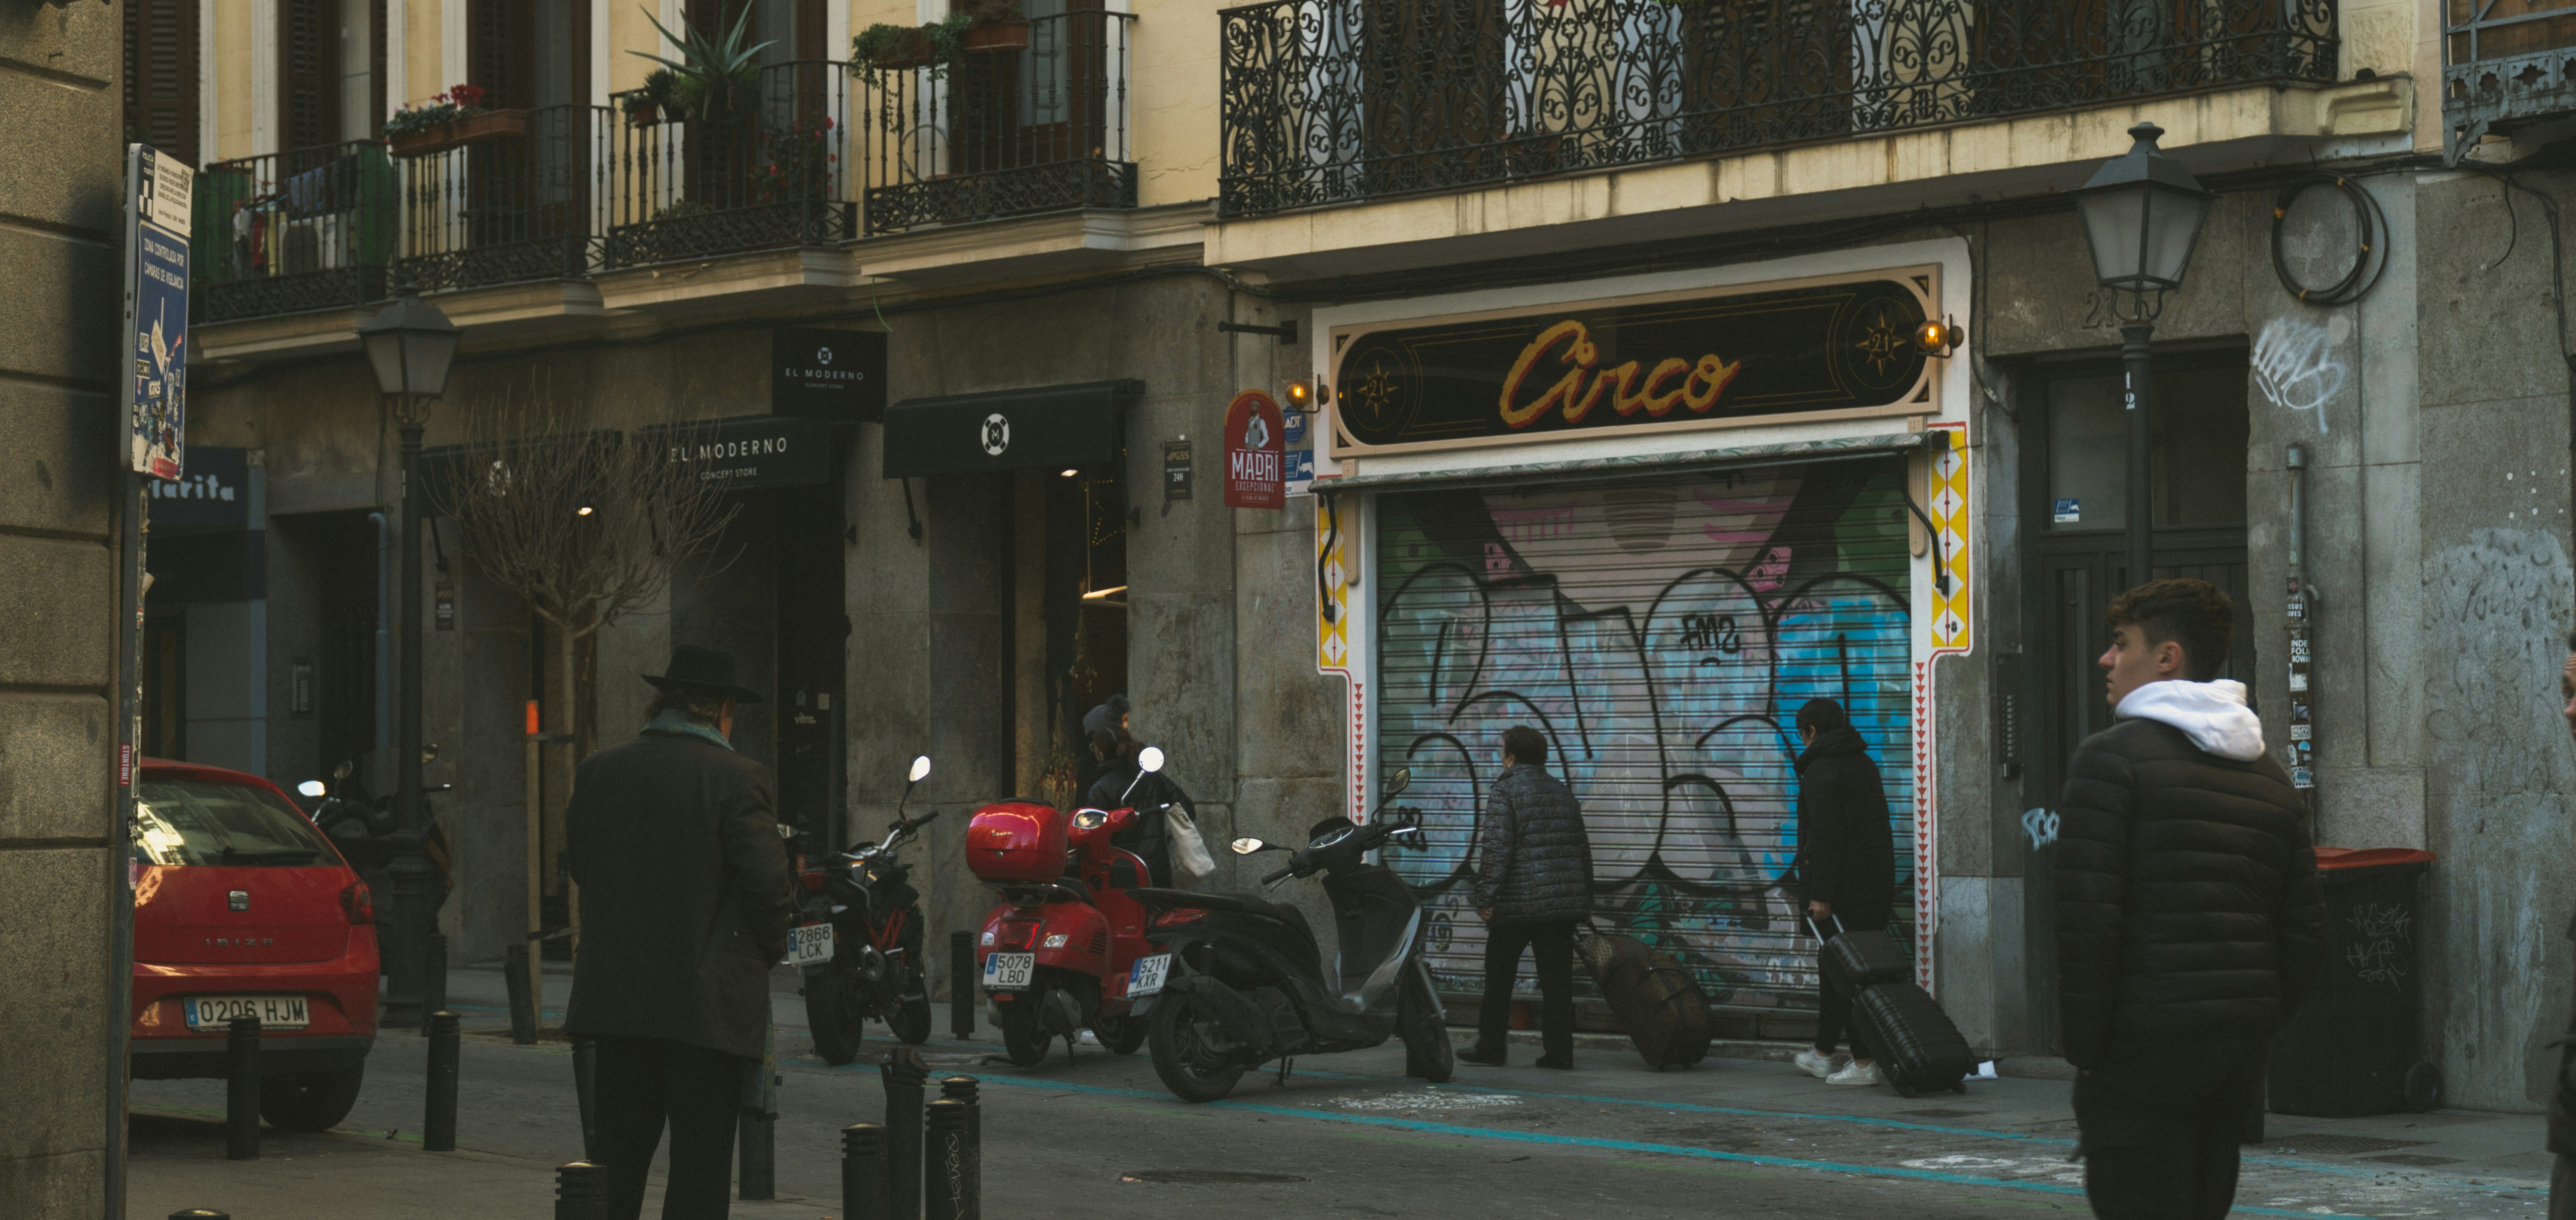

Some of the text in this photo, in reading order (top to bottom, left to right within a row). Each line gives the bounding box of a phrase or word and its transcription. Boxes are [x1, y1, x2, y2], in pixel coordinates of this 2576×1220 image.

[145, 237, 154, 253] ZONA
[155, 243, 176, 264] CONTROLADA
[144, 259, 184, 290] CÁMARAS DE VIGILANCIA
[1871, 333, 1889, 353] 21
[786, 368, 863, 380] EL MODERNO
[1500, 320, 1741, 428] Circo
[1369, 379, 1383, 398] 21
[1285, 416, 1302, 429] ADT
[671, 437, 787, 462] EL MODERNO
[700, 467, 757, 480] CONCEPT STORE
[1232, 451, 1279, 481] MADRÍ
[1173, 473, 1183, 482] 24H
[148, 474, 234, 501] larita
[1236, 481, 1274, 492] EXCEPCIONAL
[206, 938, 273, 947] IBIZA
[798, 926, 830, 944] 2866
[799, 943, 823, 959] LCK
[997, 956, 1031, 969] 5078
[1141, 956, 1167, 973] 5211
[999, 970, 1024, 983] LBD
[1136, 973, 1158, 989] KXR
[265, 1000, 305, 1022] HJM
